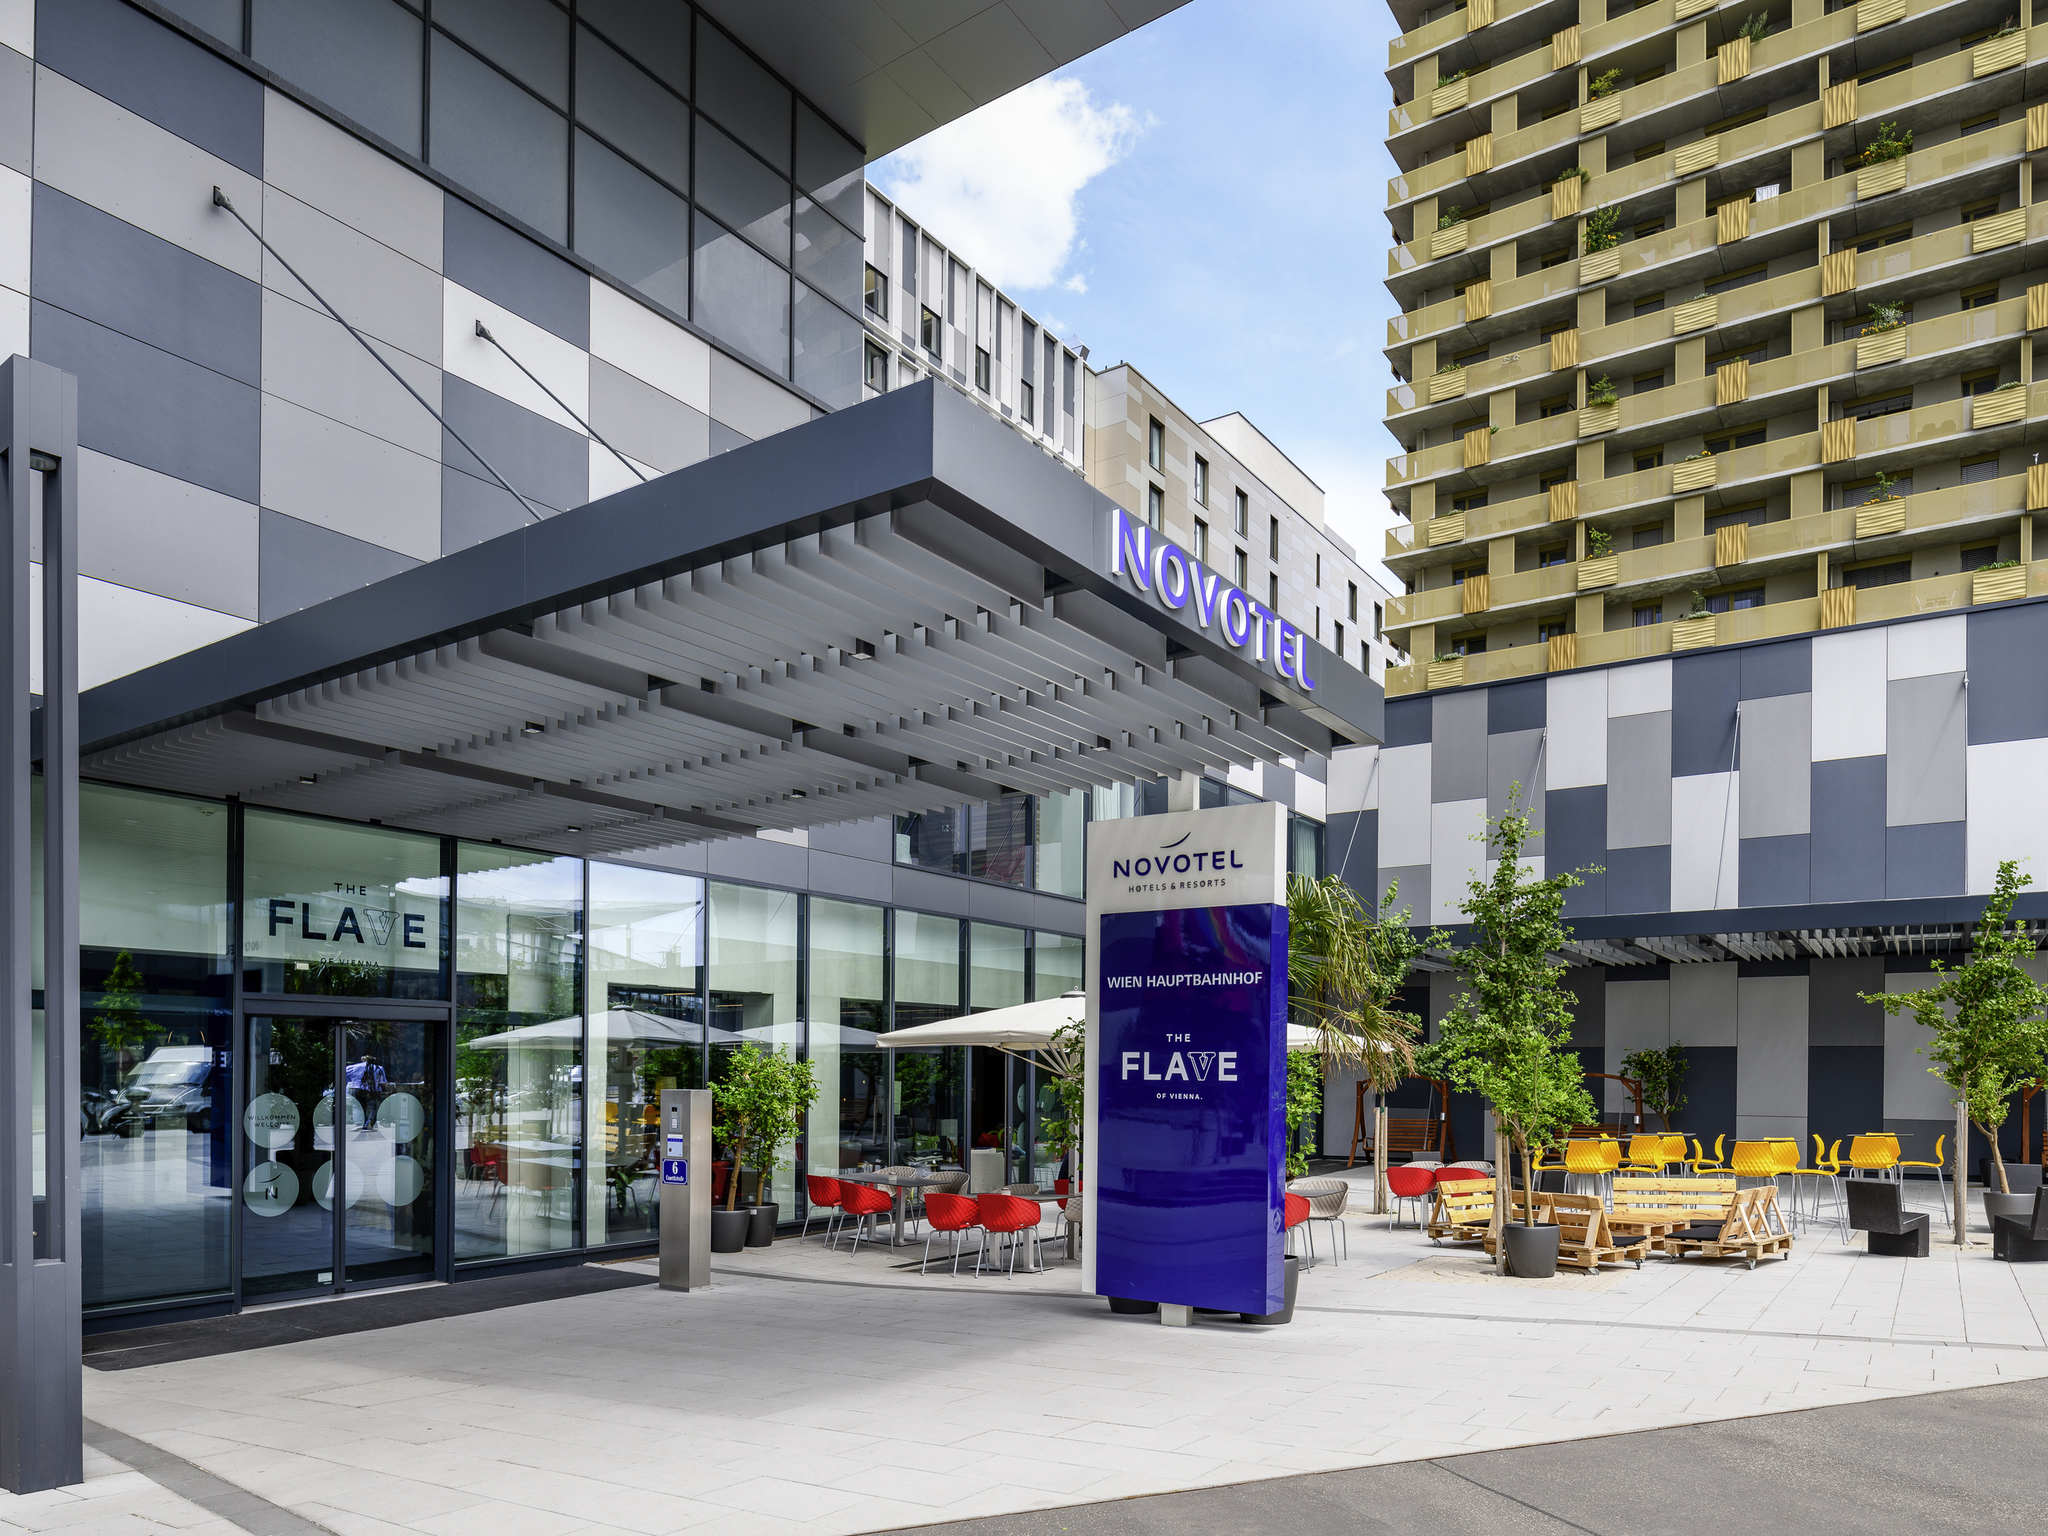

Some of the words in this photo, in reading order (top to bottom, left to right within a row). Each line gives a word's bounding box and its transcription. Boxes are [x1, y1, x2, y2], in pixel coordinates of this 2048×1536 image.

[1111, 508, 1316, 691] NOVOTEL
[1113, 849, 1243, 878] NOVOTEL
[334, 882, 367, 896] THE
[1128, 882, 1167, 893] HOTELS
[1170, 882, 1176, 890] &
[1179, 878, 1226, 889] RESORTS
[268, 898, 426, 949] FLAVE
[1107, 974, 1142, 988] WIEN
[1146, 971, 1263, 987] HAUPTBAHNHOF
[1166, 1033, 1191, 1042] THE
[1121, 1051, 1238, 1082] FLAVE
[672, 1161, 678, 1175] 6
